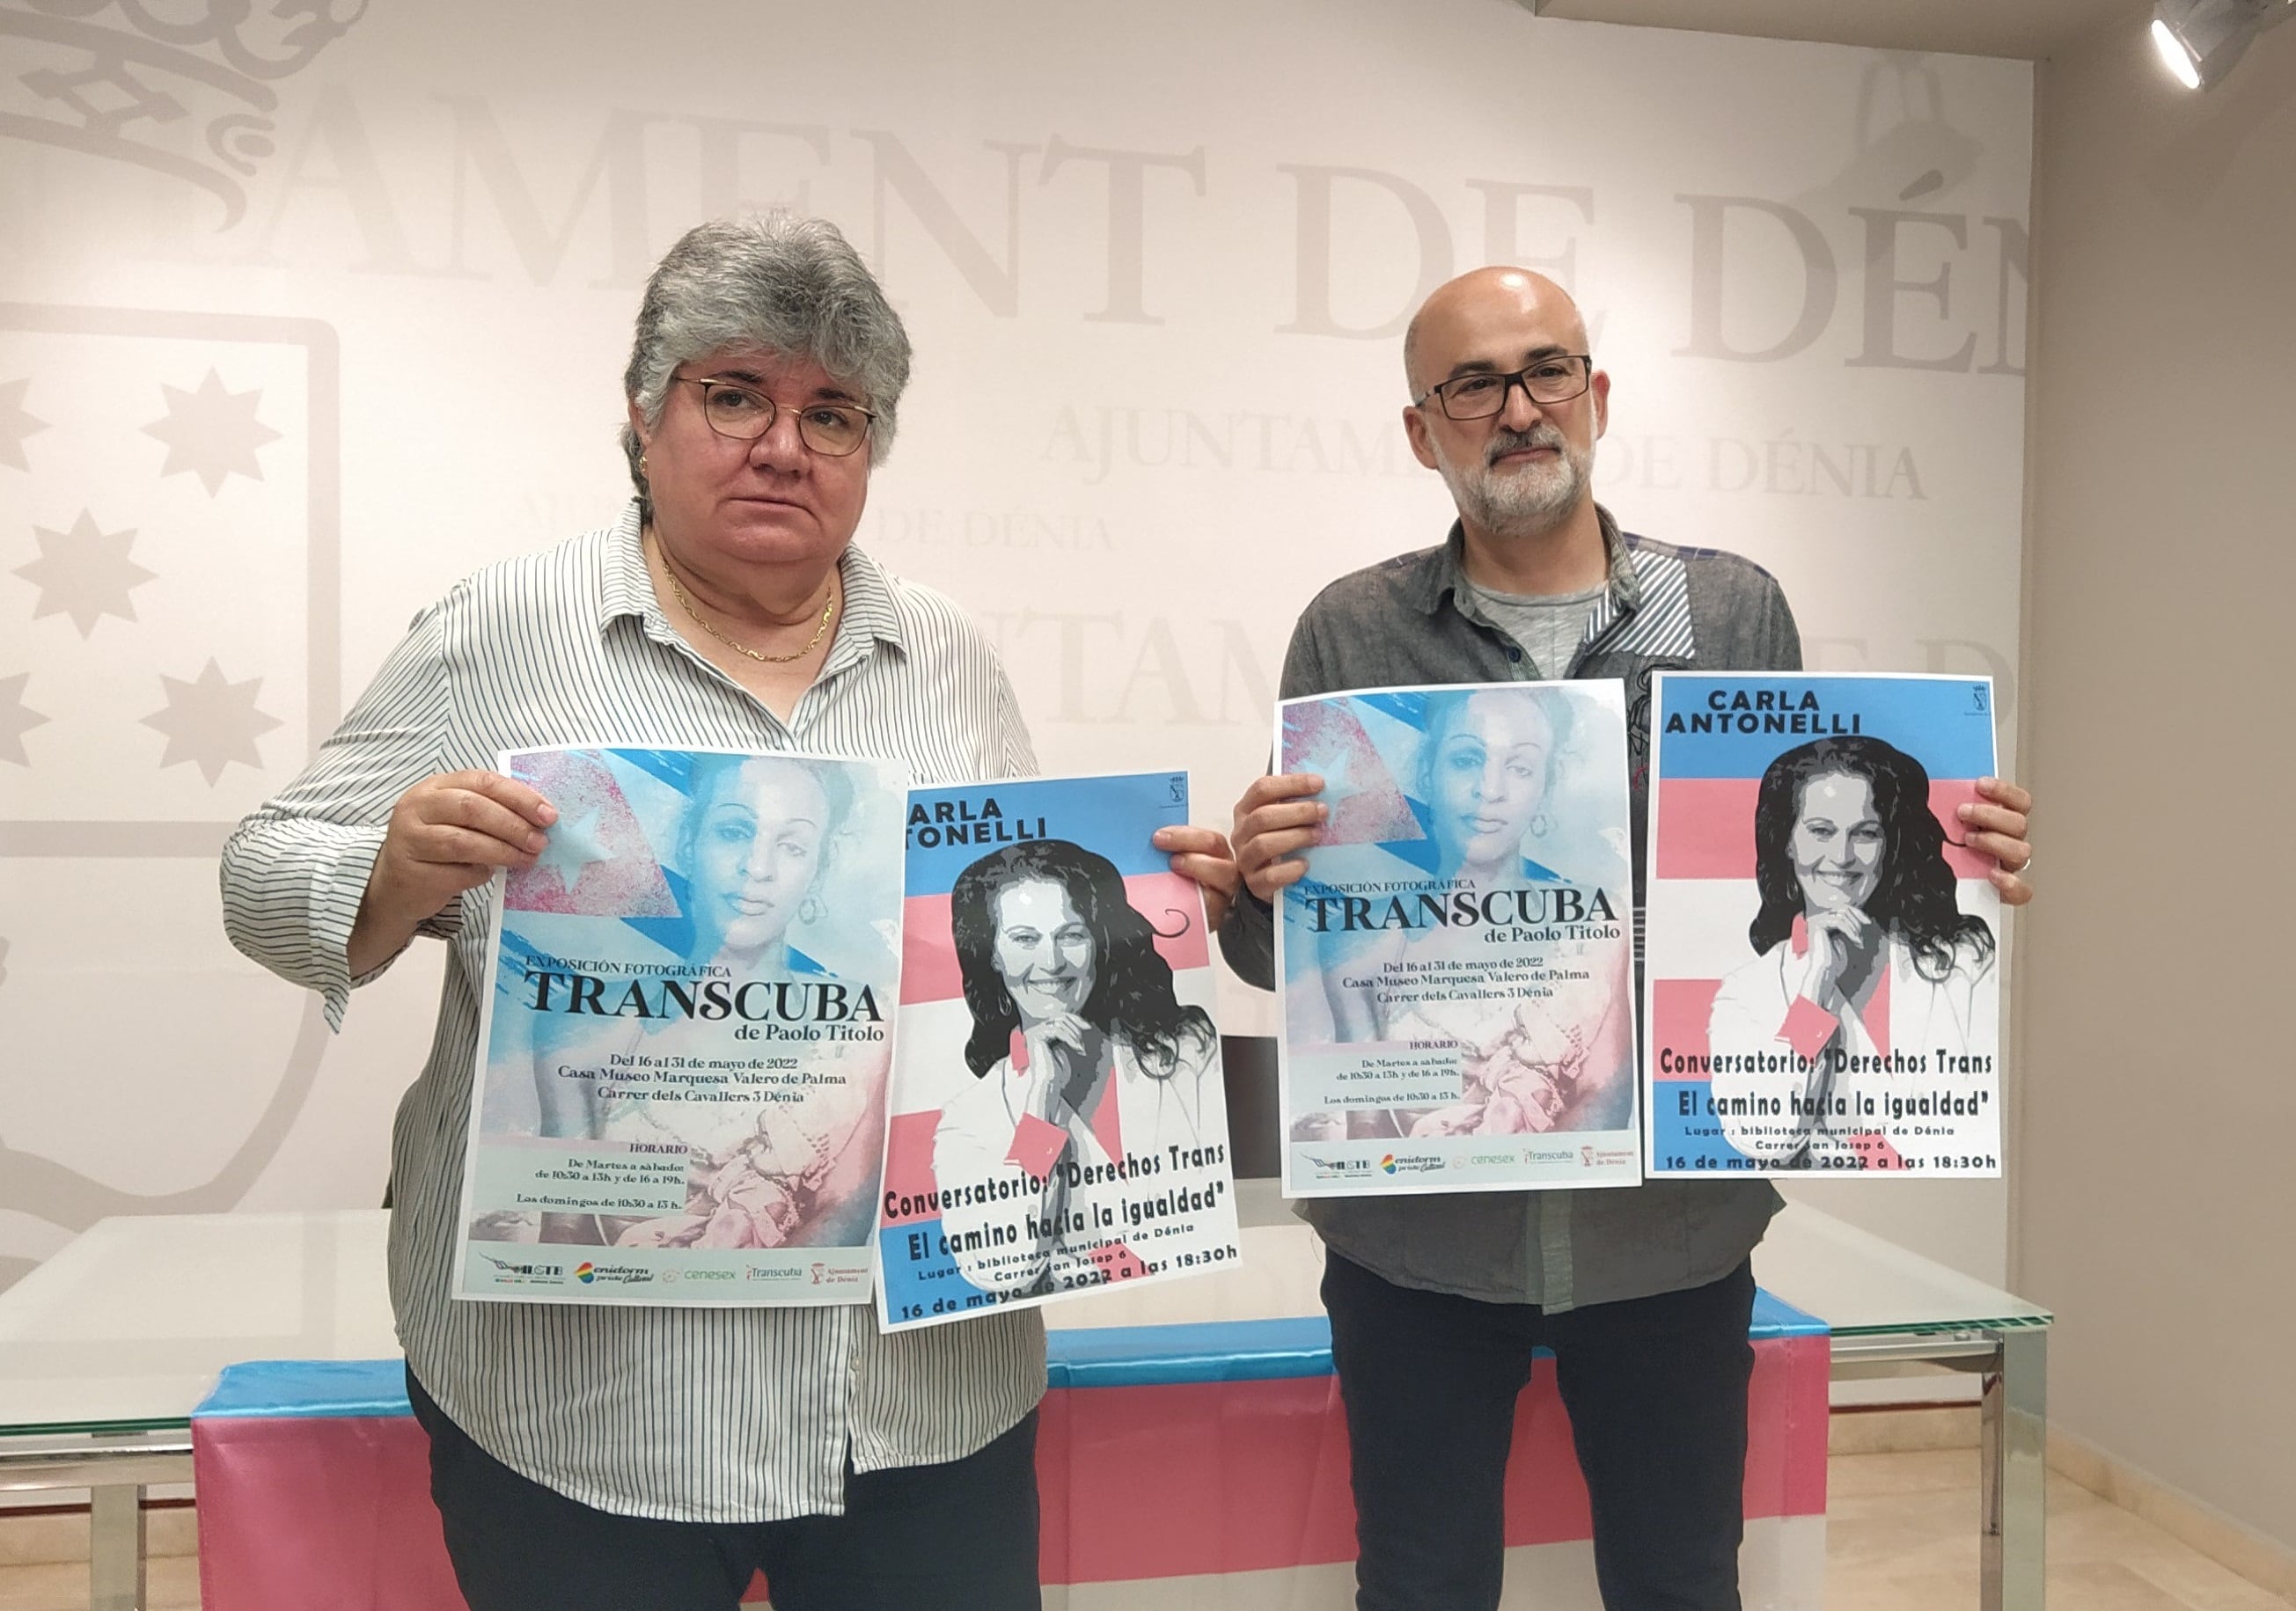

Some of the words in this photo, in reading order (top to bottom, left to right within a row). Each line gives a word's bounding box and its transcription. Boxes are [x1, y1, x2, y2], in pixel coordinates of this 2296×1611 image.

[1705, 427, 1929, 502] DÉNIA
[1708, 690, 1820, 712] CARLA
[1665, 713, 1861, 735] ANTONELLI
[1304, 881, 1381, 896] EXPOSICIÓN
[1384, 879, 1476, 892] FOTOGRÁFICA
[1305, 887, 1619, 933] TRANSCUBA
[1485, 928, 1507, 944] de
[1511, 926, 1562, 943] Paolo
[1565, 925, 1621, 941] Titolo
[525, 955, 620, 974] EXPOSICIÓN
[624, 962, 732, 978] FOTOGRÁFICA
[1383, 962, 1404, 973] Del
[1406, 962, 1418, 972] 16
[1434, 960, 1445, 971] 31
[1448, 960, 1463, 970] de
[1465, 961, 1498, 972] mayo
[1499, 959, 1515, 969] de
[1515, 956, 1544, 968] 2022
[1342, 977, 1373, 988] Casa
[1376, 976, 1419, 987] Museo
[1420, 973, 1485, 986] Marquesa
[1487, 970, 1529, 983] Valero
[1531, 970, 1546, 981] de
[1548, 969, 1590, 981] Palma
[524, 970, 885, 1022] TRANSCUBA
[1377, 991, 1419, 1003] Carrer
[1421, 990, 1447, 1002] dels
[1449, 988, 1506, 1001] Cavallers
[1507, 987, 1515, 998] 3
[1517, 986, 1553, 998] Dénia
[735, 1023, 759, 1041] de
[766, 1024, 821, 1042] Paolo
[825, 1024, 884, 1042] Titolo
[1410, 1040, 1458, 1050] HORARIO
[610, 1053, 635, 1066] Del
[639, 1056, 653, 1067] 16
[671, 1057, 685, 1068] 31
[687, 1058, 705, 1068] de
[708, 1058, 746, 1072] mayo
[748, 1058, 765, 1069] de
[767, 1058, 798, 1070] 2022
[1362, 1059, 1374, 1068] De
[1661, 1047, 1816, 1075] Conversatorio:
[1935, 1048, 1992, 1074] Trans
[558, 1065, 596, 1080] Casa
[599, 1068, 650, 1082] Museo
[653, 1071, 729, 1087] Marquesa
[733, 1072, 779, 1084] Valero
[781, 1073, 798, 1084] de
[802, 1073, 847, 1085] Palma
[598, 1086, 649, 1101] Carrer
[651, 1089, 682, 1102] dels
[685, 1090, 750, 1102] Cavallers
[752, 1091, 760, 1102] 3
[763, 1090, 804, 1102] Dénia
[1324, 1095, 1341, 1104] Los
[1343, 1095, 1391, 1104] domingos
[1678, 1091, 1697, 1117] El
[1706, 1091, 1781, 1117] camino
[1790, 1091, 1847, 1117] hacia
[1856, 1091, 1875, 1117] la
[1684, 1126, 1726, 1138] Lugar
[1741, 1125, 1811, 1136] biblioteca
[1817, 1125, 1886, 1137] municipal
[1893, 1125, 1908, 1135] de
[1914, 1125, 1955, 1136] Dénia
[629, 1143, 688, 1154] HORARIO
[1756, 1140, 1799, 1150] Carrer
[1835, 1141, 1871, 1151] Josep
[1877, 1140, 1884, 1149] 6
[568, 1158, 583, 1168] De
[586, 1159, 627, 1170] Martes
[1471, 1154, 1515, 1165] cenesex
[1667, 1156, 1686, 1169] 16
[1695, 1154, 1717, 1169] de
[1727, 1157, 1780, 1170] mayo
[1790, 1155, 1812, 1168] de
[1821, 1155, 1868, 1169] 2022
[1877, 1158, 1889, 1168] a
[1897, 1153, 1925, 1168] las
[1933, 1154, 1996, 1168] 18:30h
[535, 1169, 550, 1178] de
[592, 1172, 611, 1182] 13h
[614, 1175, 620, 1185] y
[623, 1174, 637, 1183] de
[640, 1175, 650, 1183] 16
[884, 1174, 1048, 1219] Conversatorio:
[1168, 1144, 1225, 1172] Trans
[517, 1193, 538, 1203] Los
[539, 1195, 599, 1208] domingos
[908, 1232, 929, 1261] El
[939, 1222, 1017, 1255] camino
[1025, 1206, 1085, 1241] hacia
[1093, 1202, 1114, 1228] la
[919, 1265, 961, 1281] Lugar
[978, 1248, 1050, 1270] biblioteca
[1057, 1234, 1126, 1256] municipal
[1133, 1232, 1148, 1242] de
[1155, 1224, 1194, 1239] Dénia
[684, 1270, 736, 1280] cenesex
[751, 1267, 803, 1278] Transcuba
[994, 1267, 1039, 1282] Carrer
[1077, 1253, 1112, 1268] Josep
[1119, 1250, 1126, 1259] 6
[902, 1304, 923, 1319] 16
[933, 1298, 957, 1314] de
[966, 1286, 1023, 1308] mayo
[1063, 1268, 1112, 1290] 2022
[1121, 1265, 1132, 1278] a
[1141, 1259, 1168, 1275] las
[1176, 1244, 1237, 1269] 18:30h
